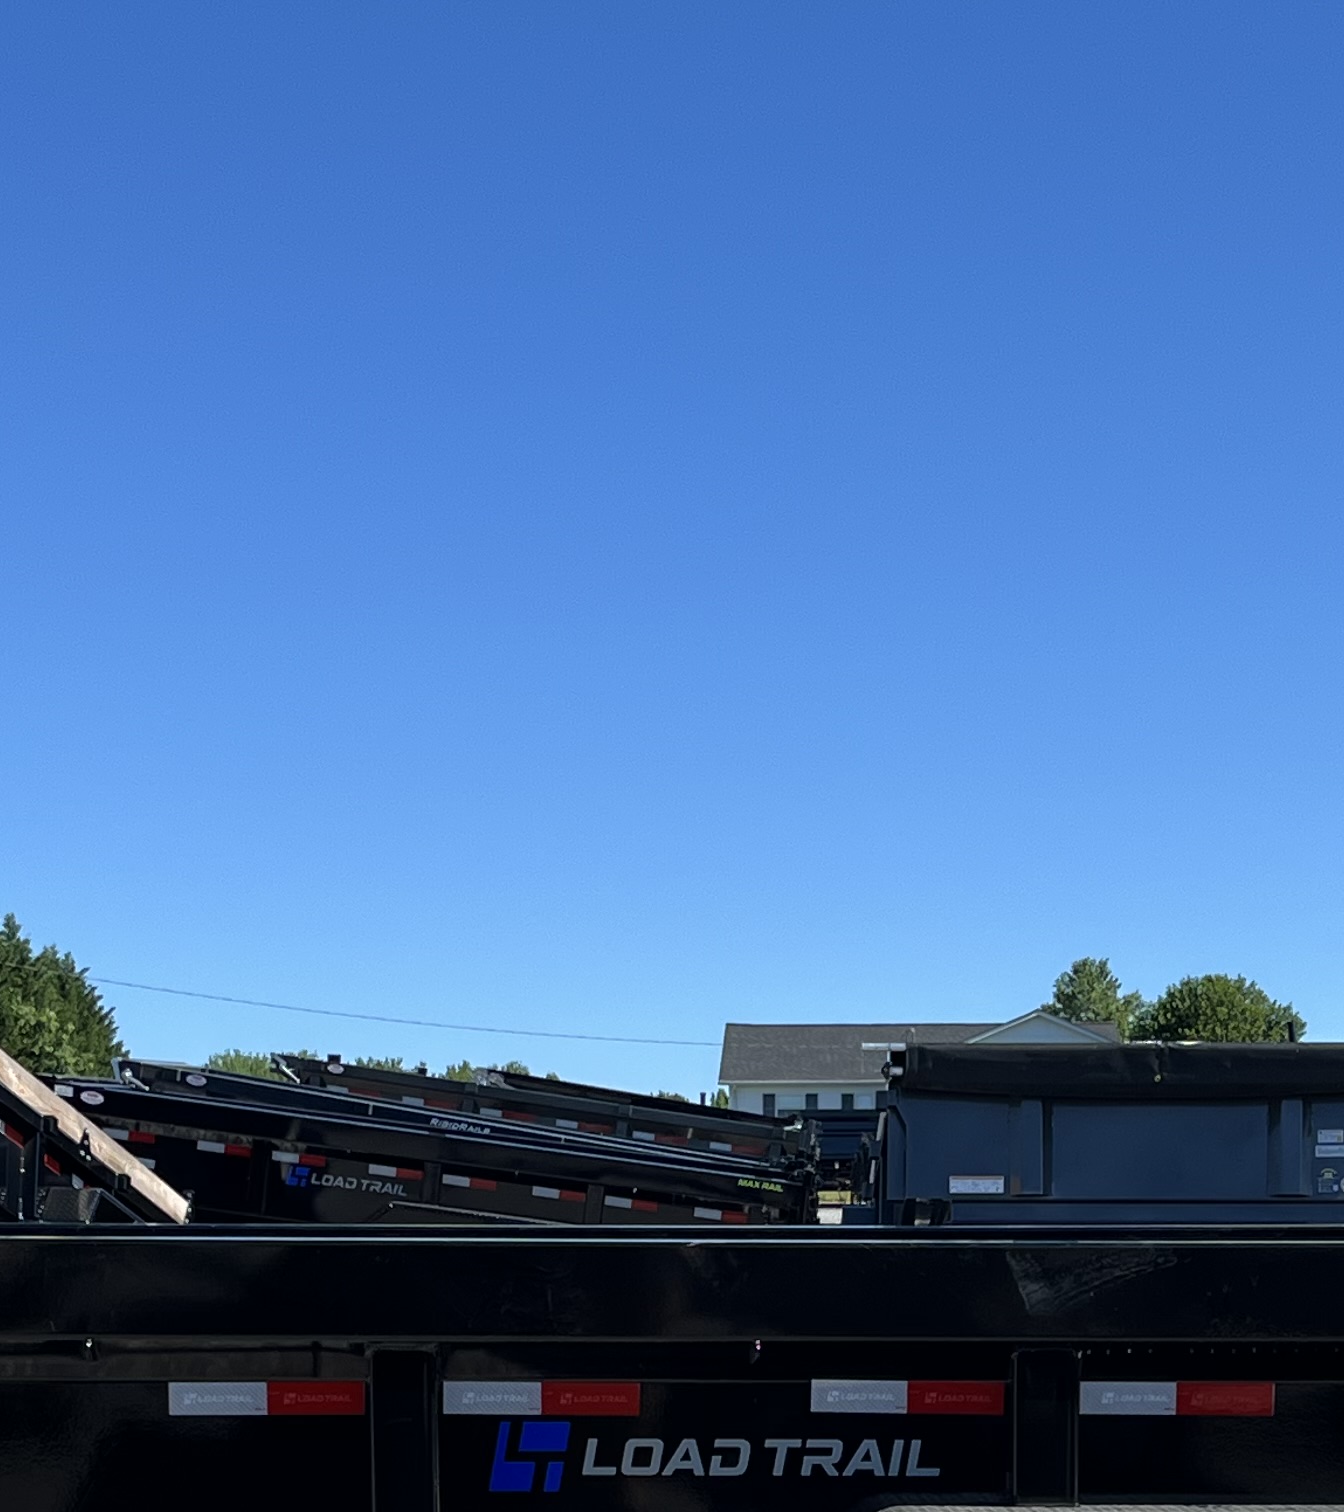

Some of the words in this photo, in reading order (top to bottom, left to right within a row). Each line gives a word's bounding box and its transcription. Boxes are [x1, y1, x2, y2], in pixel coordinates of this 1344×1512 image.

[311, 1172, 357, 1190] LOAD
[360, 1179, 408, 1197] TRAIL
[582, 1438, 752, 1477] LOAD
[763, 1438, 941, 1477] TRAIL
